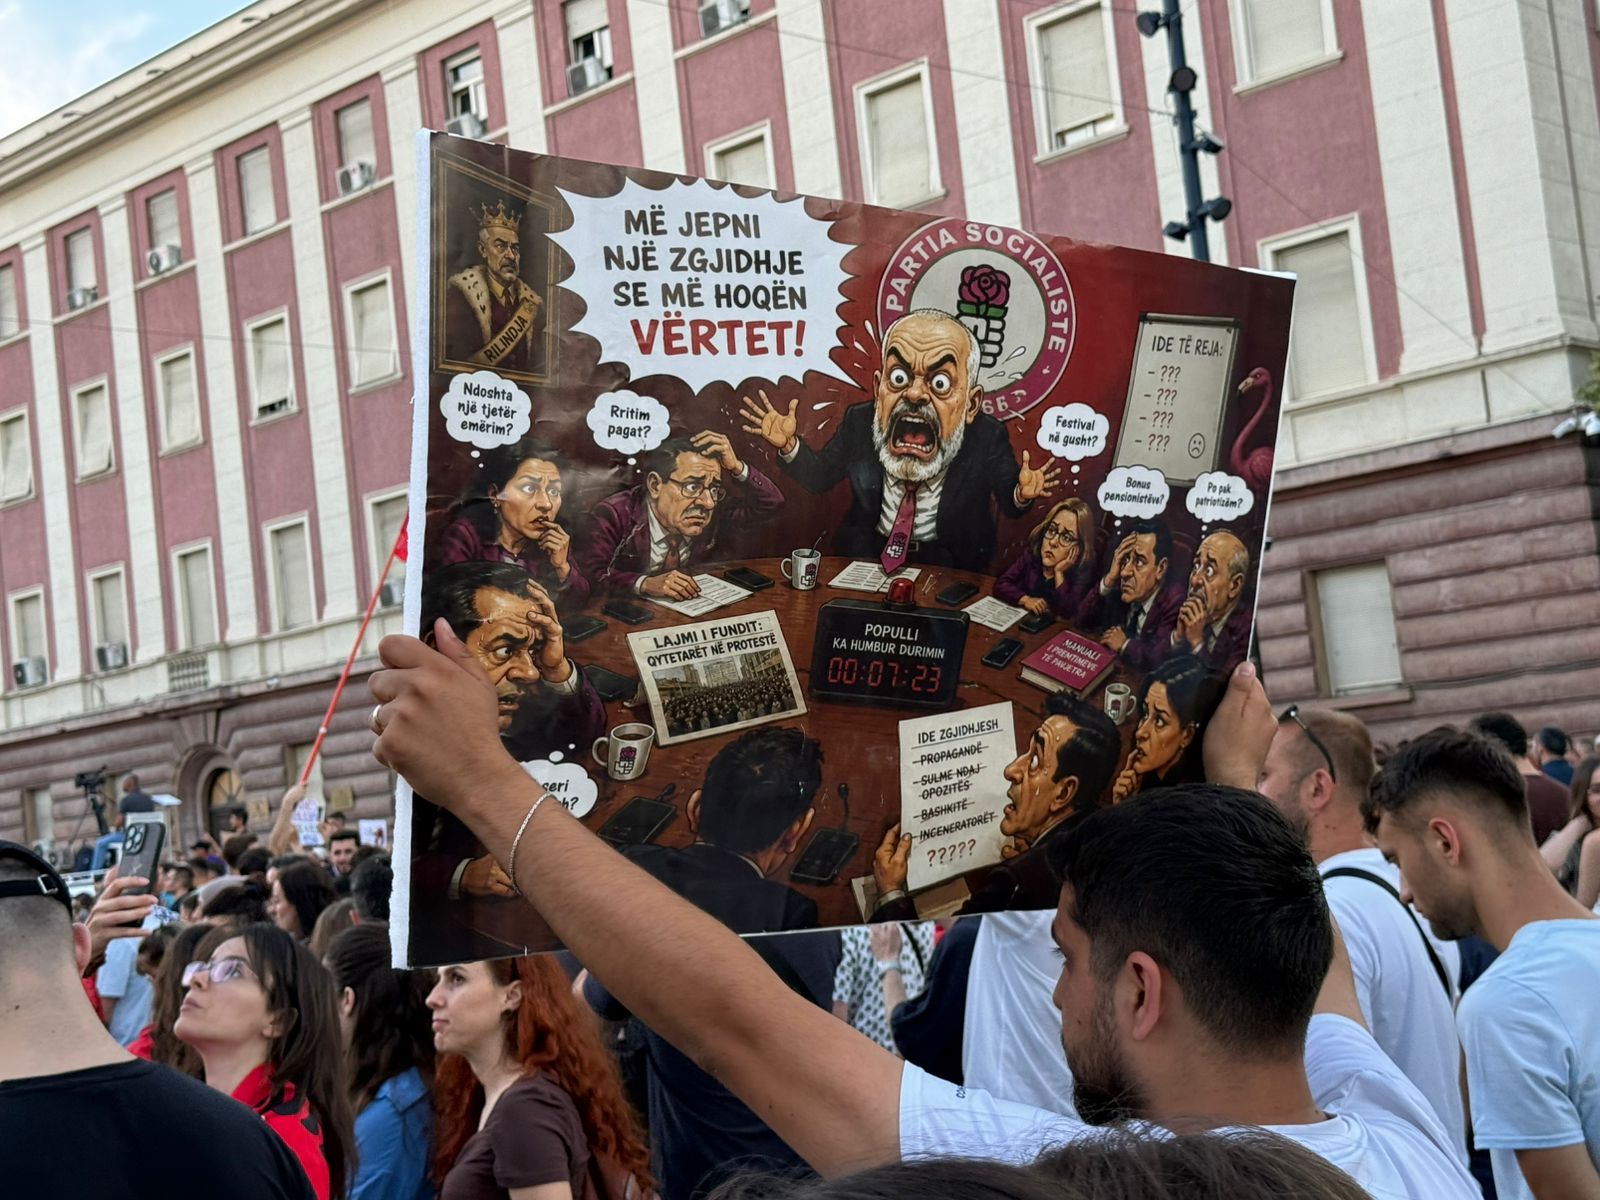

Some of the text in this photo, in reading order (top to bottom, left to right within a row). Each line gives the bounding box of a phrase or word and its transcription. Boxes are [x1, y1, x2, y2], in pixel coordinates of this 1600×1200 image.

[624, 204, 761, 239] MË JEPNI
[603, 240, 804, 276] NJË ZGJIDHJE
[613, 277, 807, 312] SE MË HOQËN
[886, 223, 1068, 353] PARTIA SOCIALISTE
[483, 315, 528, 362] RILINDJA
[630, 311, 806, 357] VËRTET!
[1151, 335, 1224, 357] IDE TË REJA:
[1161, 365, 1181, 383] ???
[463, 382, 513, 401] Ndoshta
[1157, 388, 1177, 406] ???
[458, 400, 517, 419] një tjetër
[610, 405, 650, 421] Rritim
[1152, 411, 1174, 429] ???
[460, 420, 514, 436] emërim?
[607, 424, 651, 439] pagat?
[1056, 415, 1095, 431] Festival
[1048, 432, 1098, 447] në gusht?
[1148, 433, 1170, 452] ???
[1126, 476, 1151, 489] Bonus
[1207, 482, 1231, 494] Po pak
[1104, 492, 1164, 505] pensionistëve?
[1195, 495, 1243, 508] patriotizëm?
[653, 620, 763, 649] LAJMI I FUNDIT:
[864, 623, 919, 641] POPULLI
[647, 633, 777, 667] QYTETARËT NË PROTESTË
[832, 637, 945, 659] KA HUMBUR DURIMIN
[1041, 652, 1053, 662] TË
[1051, 646, 1098, 671] PREMTIMEVE
[1062, 639, 1101, 661] MANUALI
[827, 657, 942, 692] 00:07:23
[918, 718, 999, 744] IDE ZGJIDHJESH
[920, 741, 983, 766] PROPAGANDË
[921, 763, 980, 786] SULME NDAJ
[921, 780, 970, 800] OPOZITËS
[921, 797, 968, 820] BASHKITË
[927, 839, 976, 867] ?????
